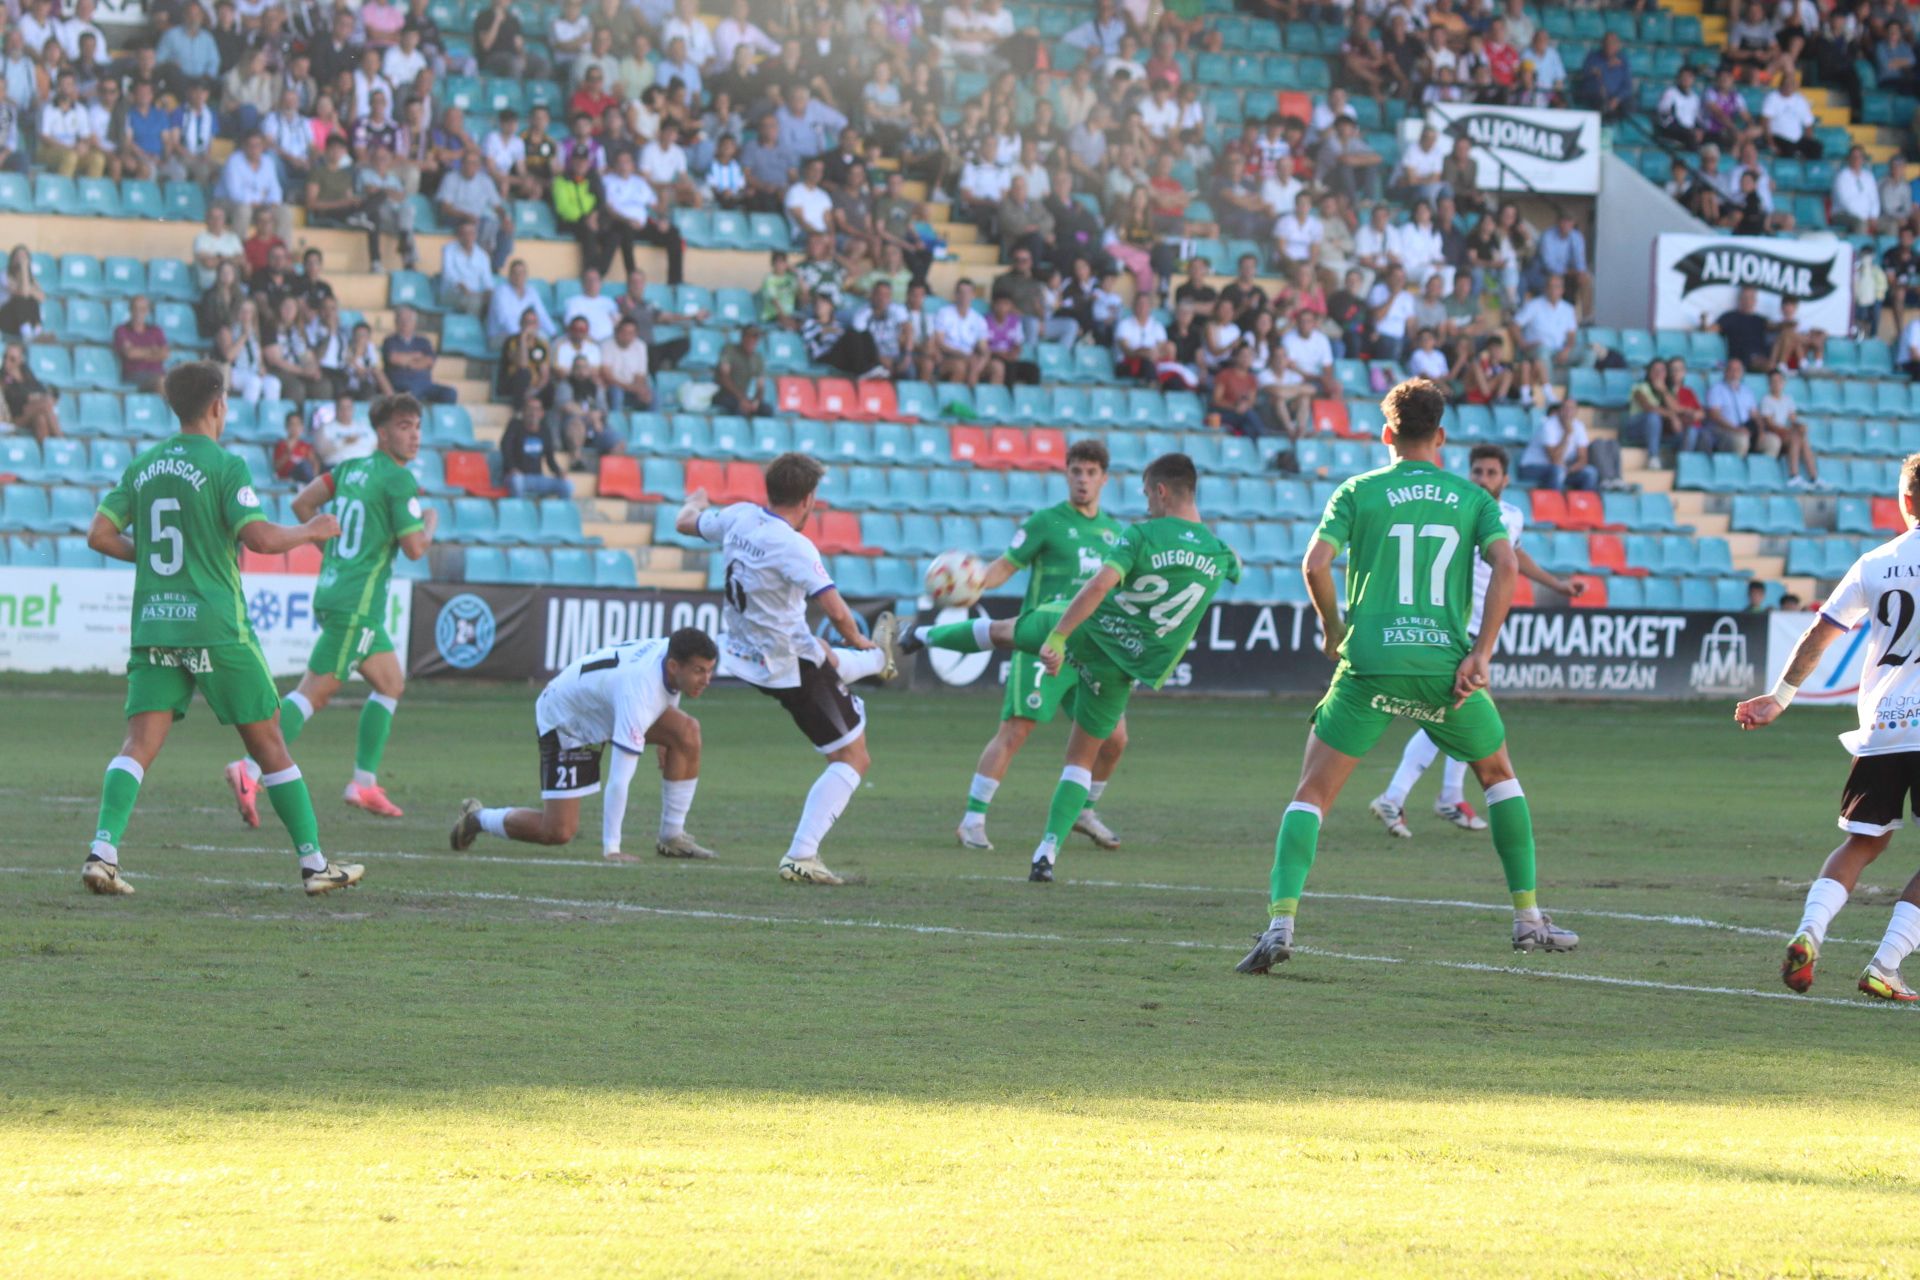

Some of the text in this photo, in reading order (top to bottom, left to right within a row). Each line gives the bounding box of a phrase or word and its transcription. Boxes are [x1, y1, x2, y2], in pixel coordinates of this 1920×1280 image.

[1467, 117, 1564, 160] ALJOMAR
[1701, 251, 1813, 296] ALJOMAR
[133, 458, 207, 492] CARRASCAL
[1386, 484, 1460, 509] ÁNGEL P.
[150, 498, 184, 577] 5
[332, 496, 366, 560] 10
[1151, 549, 1195, 570] DIEGO
[1387, 524, 1461, 607] 17
[1883, 564, 1920, 579] JUA
[142, 605, 198, 619] PASTOR
[1114, 574, 1207, 639] 24
[1383, 629, 1452, 645] PASTOR
[1876, 588, 1920, 668] 2
[1033, 661, 1046, 689] 7
[1568, 664, 1597, 690] DE
[1599, 661, 1657, 690] AZÁN
[555, 765, 577, 789] 21
